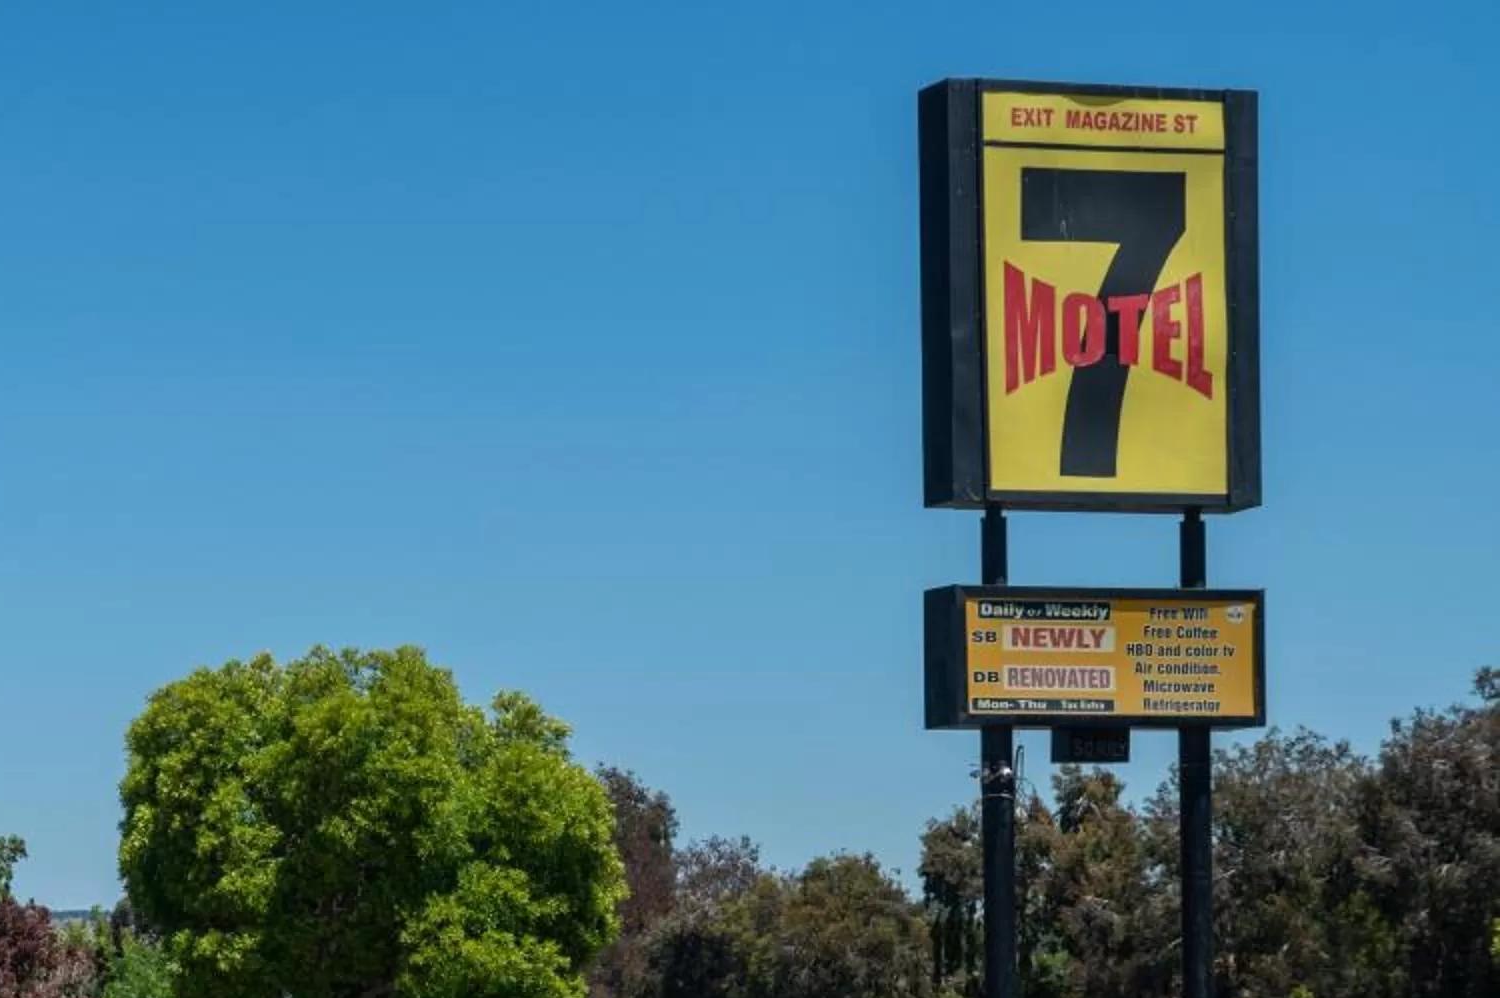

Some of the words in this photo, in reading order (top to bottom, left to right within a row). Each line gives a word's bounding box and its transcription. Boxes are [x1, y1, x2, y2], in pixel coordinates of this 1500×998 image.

[1011, 107, 1055, 128] EXIT
[1065, 110, 1167, 133] MAGAZINE
[1173, 113, 1198, 134] ST
[1021, 167, 1186, 477] 7
[1003, 260, 1213, 400] MOTEL
[981, 603, 1024, 619] Daily
[1044, 604, 1109, 620] Weekly
[1149, 607, 1178, 620] Free
[972, 631, 997, 643] SB
[1011, 627, 1107, 649] NEWLY
[1143, 625, 1171, 639] Free
[1176, 626, 1218, 640] Coffee
[1157, 645, 1181, 657] and
[1185, 644, 1219, 657] color
[1223, 644, 1235, 657] tv
[1135, 661, 1152, 675] Air
[973, 671, 999, 683] DB
[1008, 667, 1111, 689] RENOVATED
[1143, 679, 1215, 693] Microwave
[1017, 700, 1047, 710] Thu
[1143, 697, 1221, 712] Refrigerator
